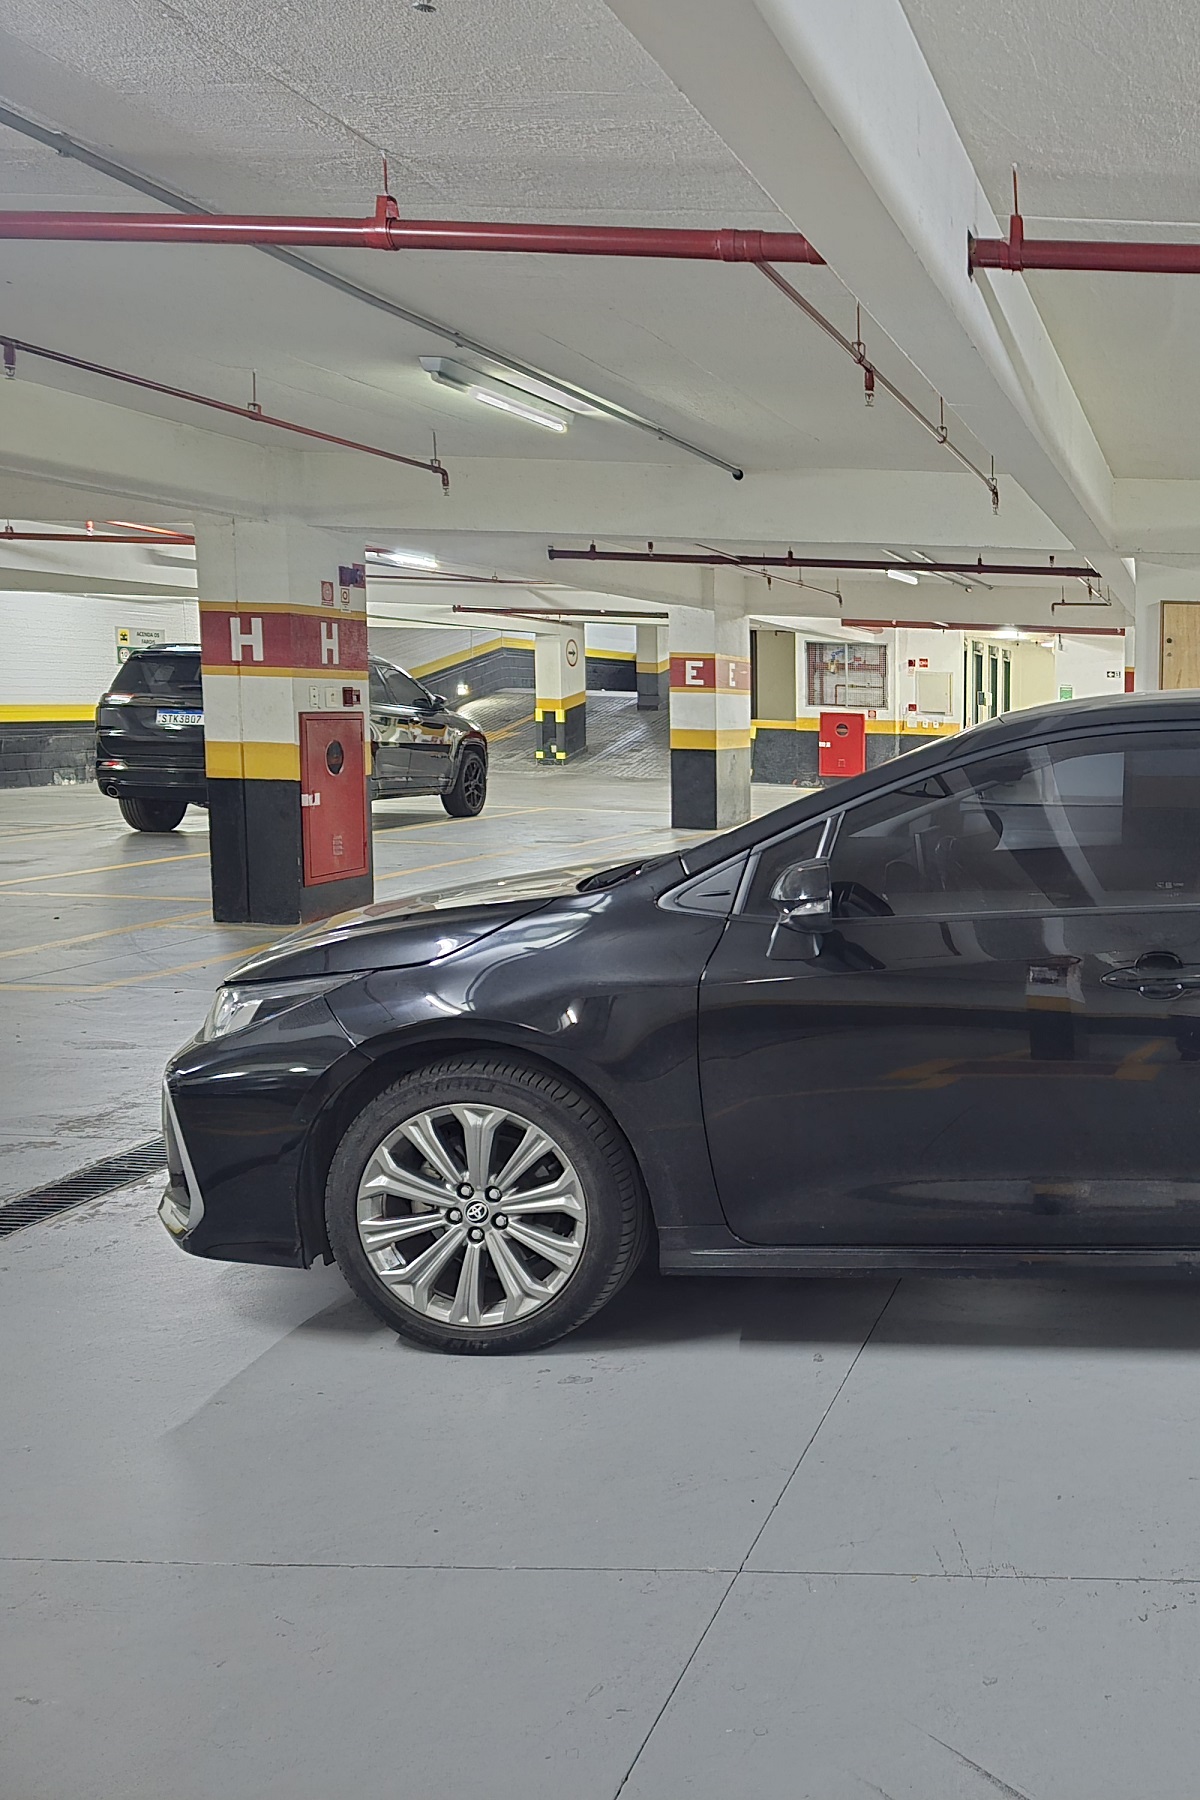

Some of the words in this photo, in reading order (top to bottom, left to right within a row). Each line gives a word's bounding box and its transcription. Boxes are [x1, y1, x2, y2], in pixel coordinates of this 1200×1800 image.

[229, 617, 264, 661] H
[320, 622, 340, 665] H
[685, 660, 704, 685] E
[729, 663, 736, 687] E
